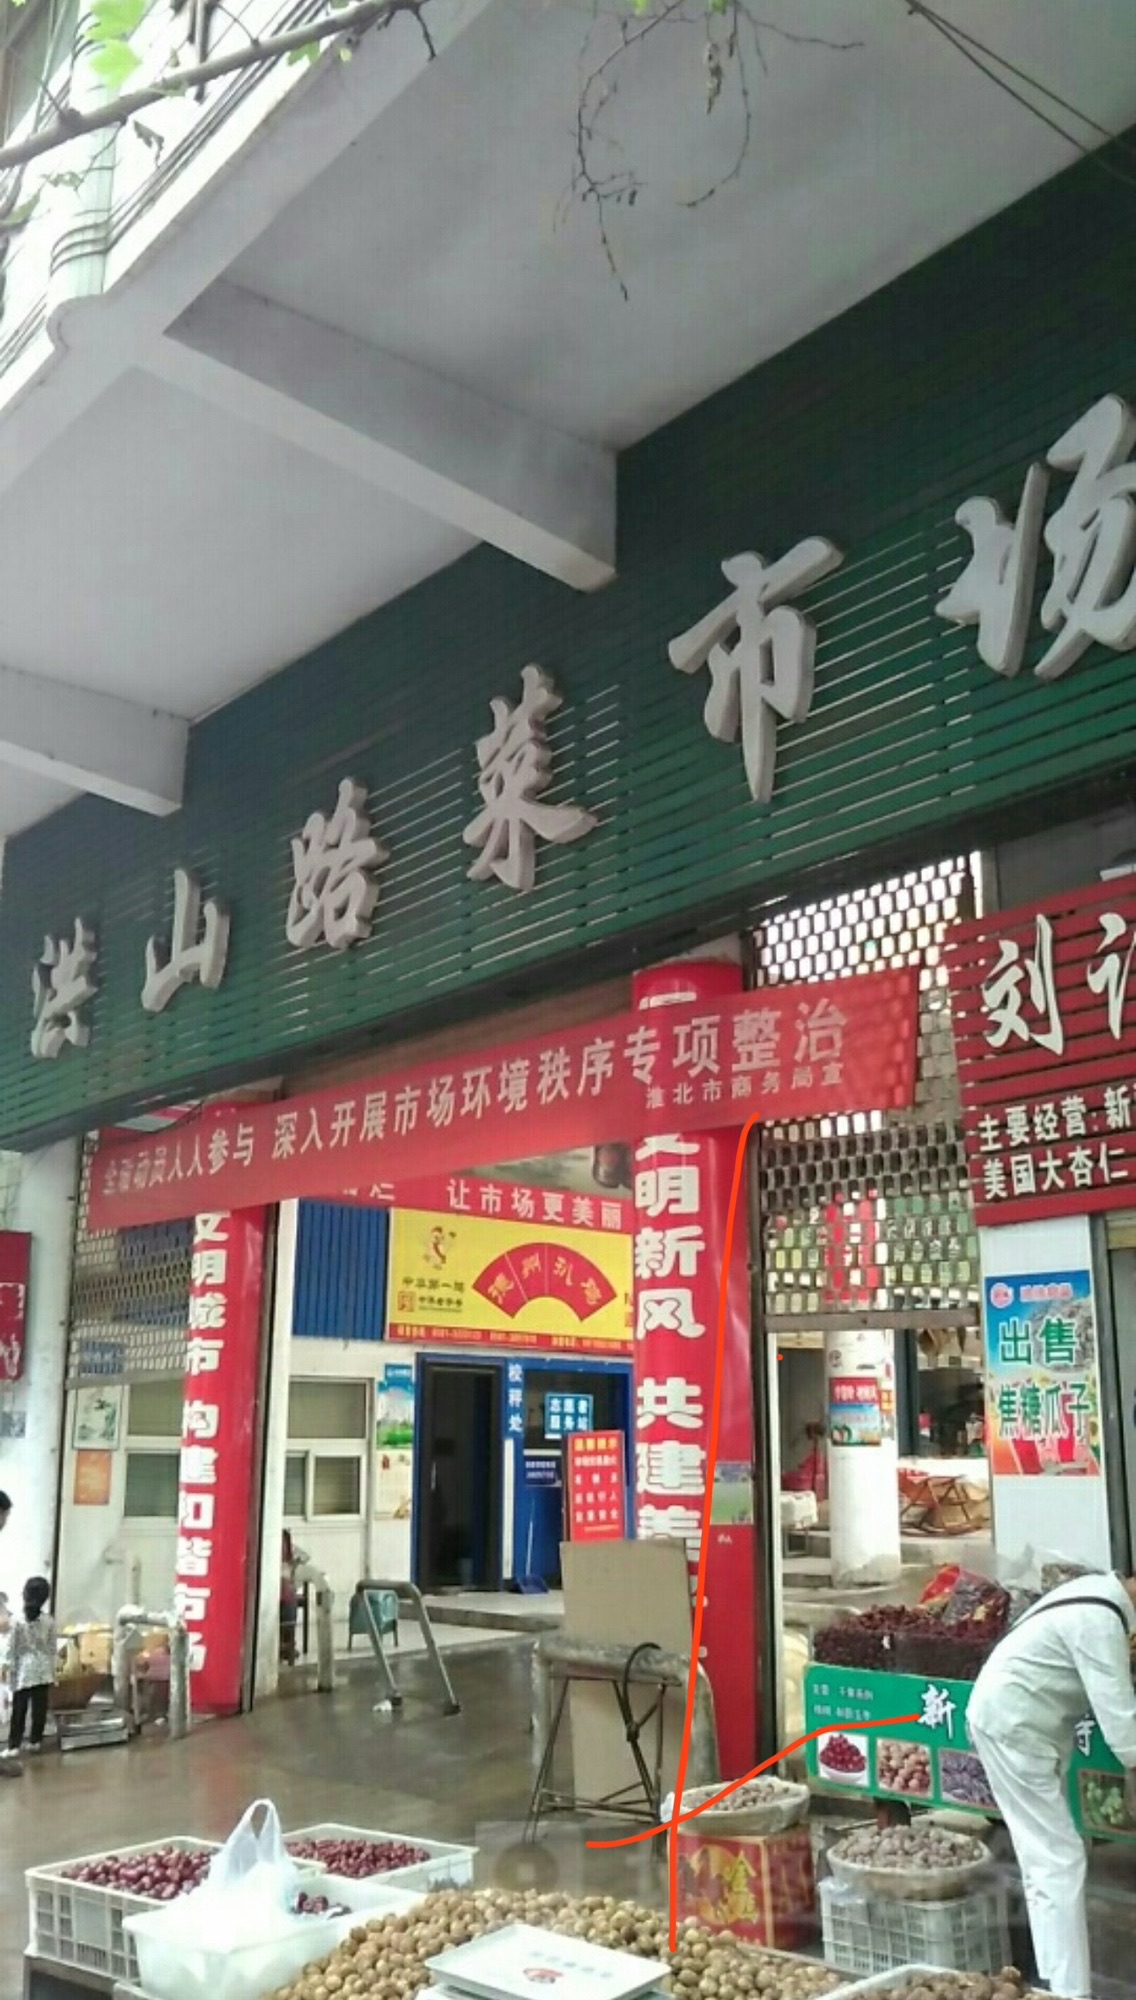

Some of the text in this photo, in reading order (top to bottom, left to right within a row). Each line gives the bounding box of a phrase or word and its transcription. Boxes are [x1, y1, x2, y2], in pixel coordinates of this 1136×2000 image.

[30, 392, 1136, 1058] 洪山路菜市场
[103, 998, 847, 1195] 全面动员人人参与 深入开展市场环境秩序专项整治
[646, 1062, 844, 1109] 淮北市商务局宣
[978, 1086, 1136, 1152] 主要经营:新
[983, 1142, 1129, 1200] 美国大杏仁
[446, 1179, 622, 1230] 让市场更美丽
[1000, 1317, 1076, 1366] 出售
[998, 1381, 1091, 1438] 焦糖瓜子
